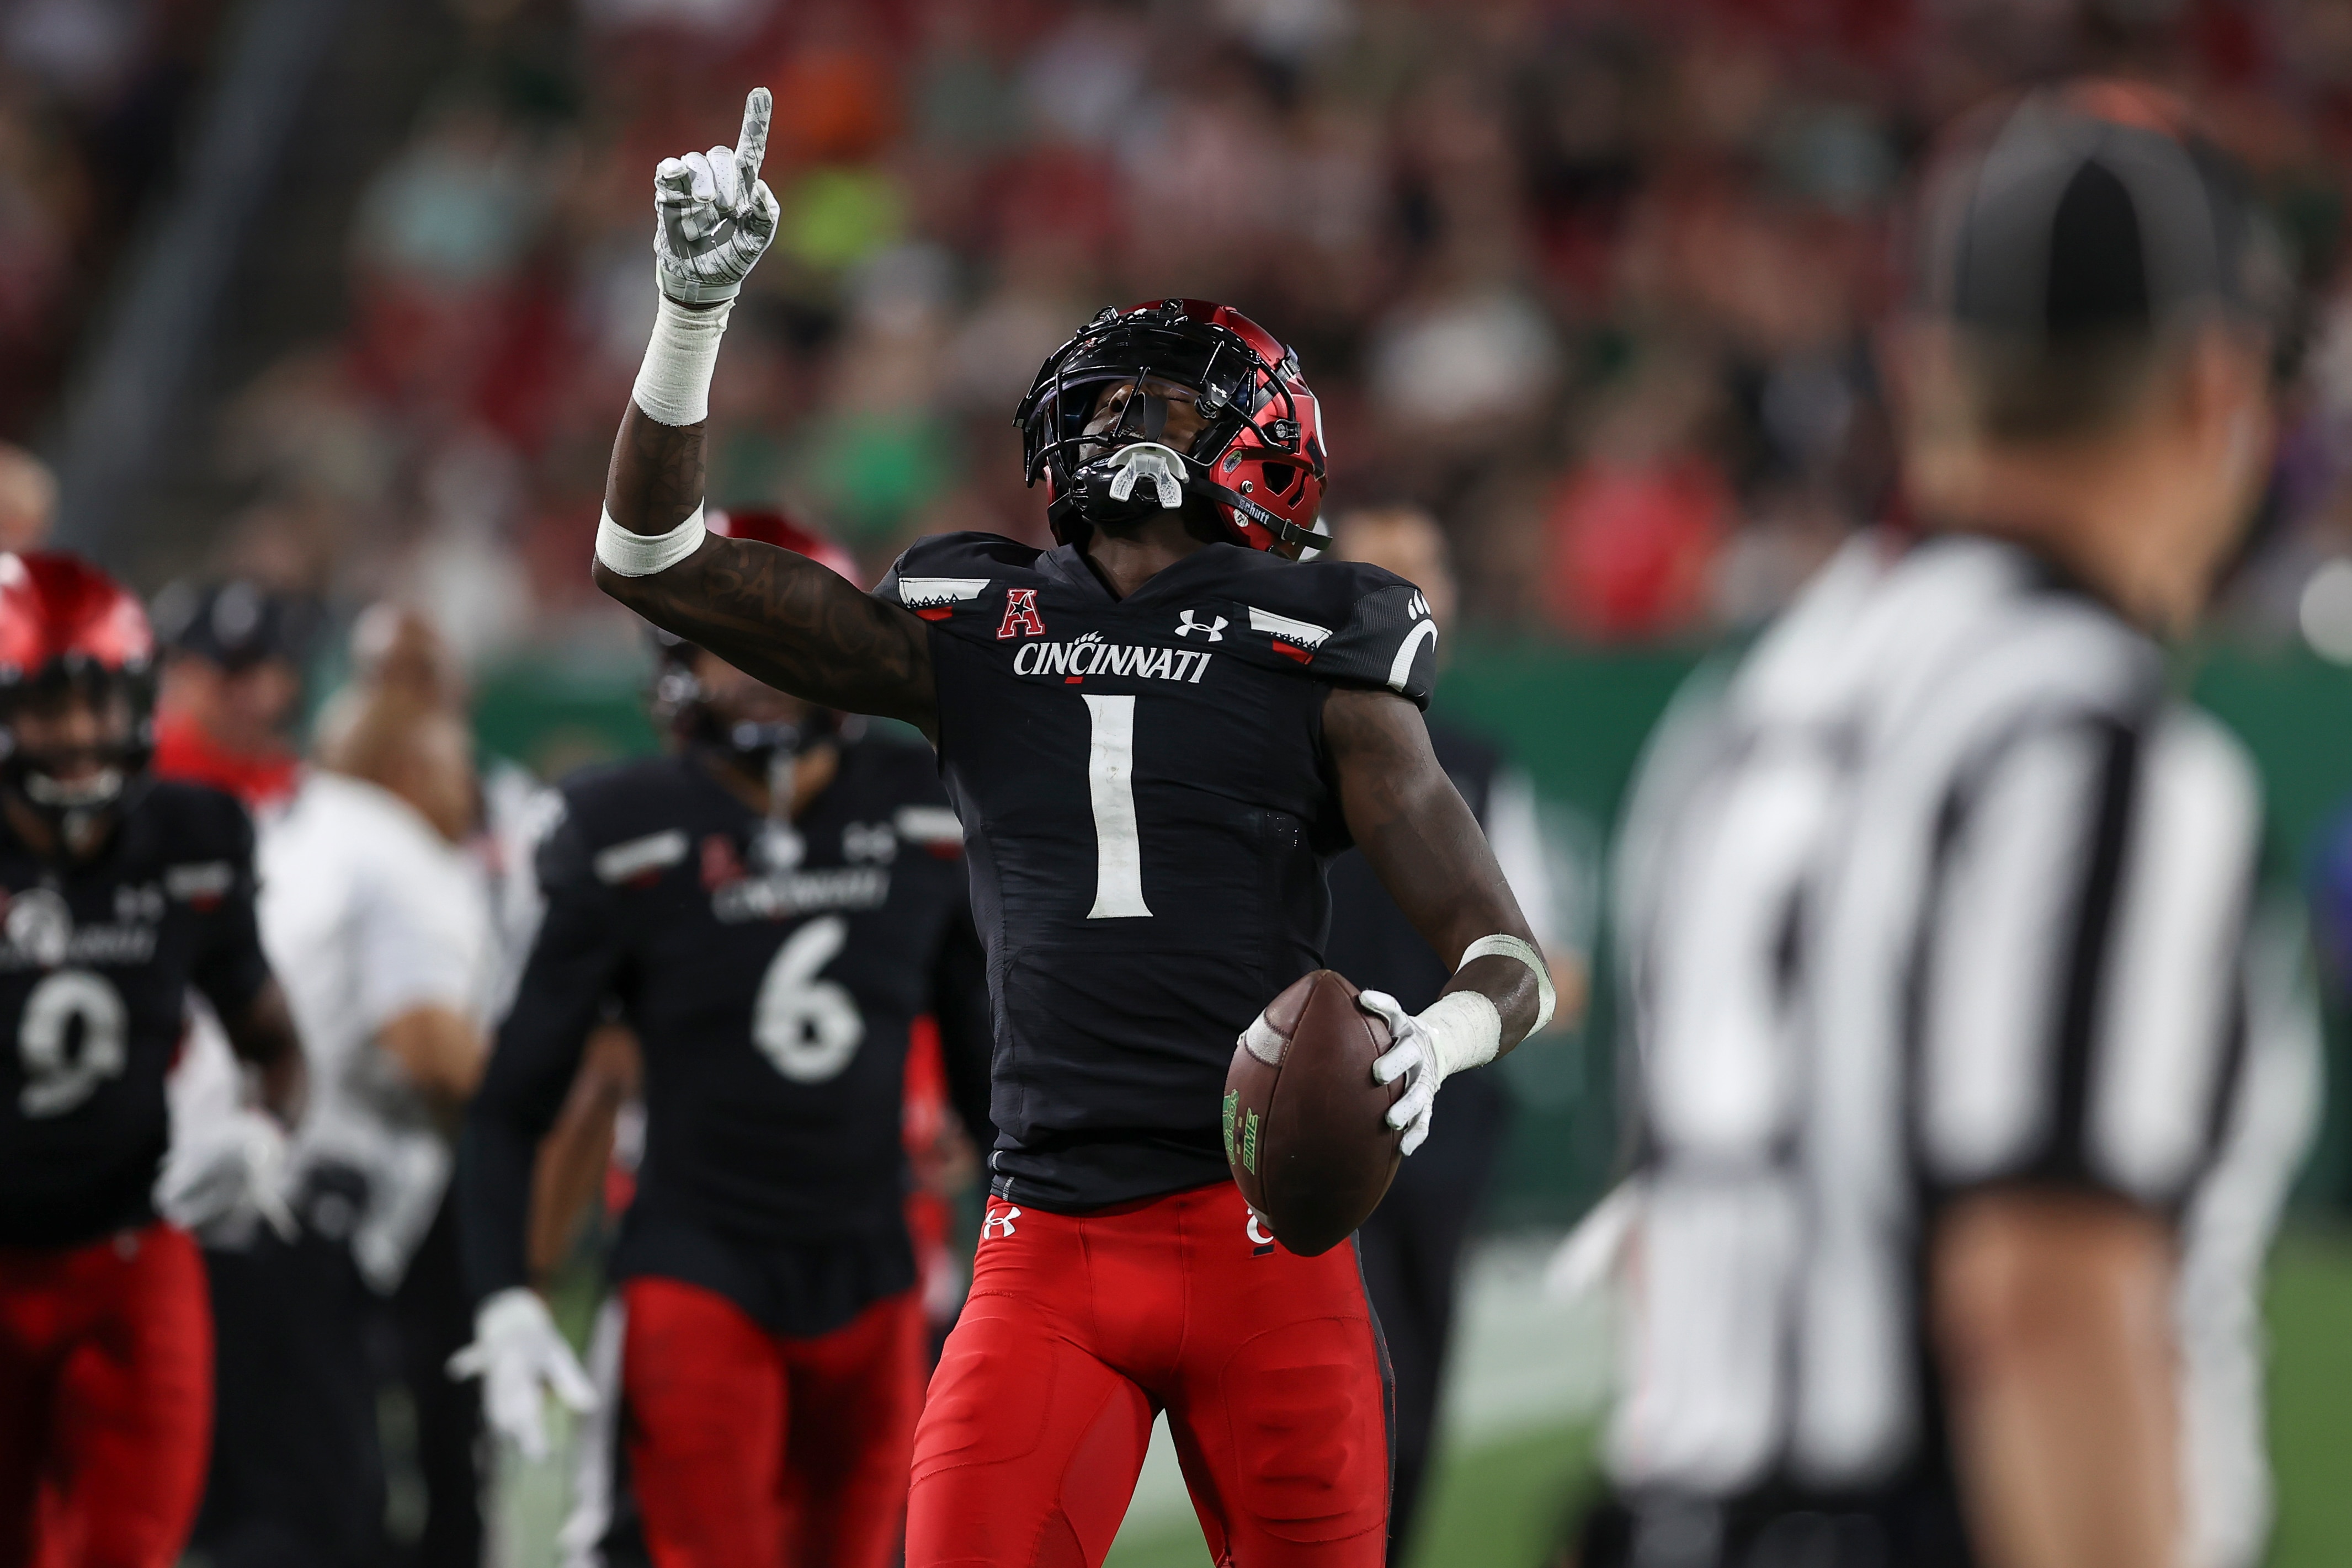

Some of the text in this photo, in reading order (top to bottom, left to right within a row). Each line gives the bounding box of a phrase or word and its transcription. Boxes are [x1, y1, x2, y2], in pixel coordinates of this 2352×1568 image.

[1013, 630, 1212, 684] CINCINNATI
[1081, 694, 1153, 919] 1
[18, 971, 131, 1118] 9
[752, 916, 865, 1083] 6
[1243, 1107, 1260, 1176] DIME
